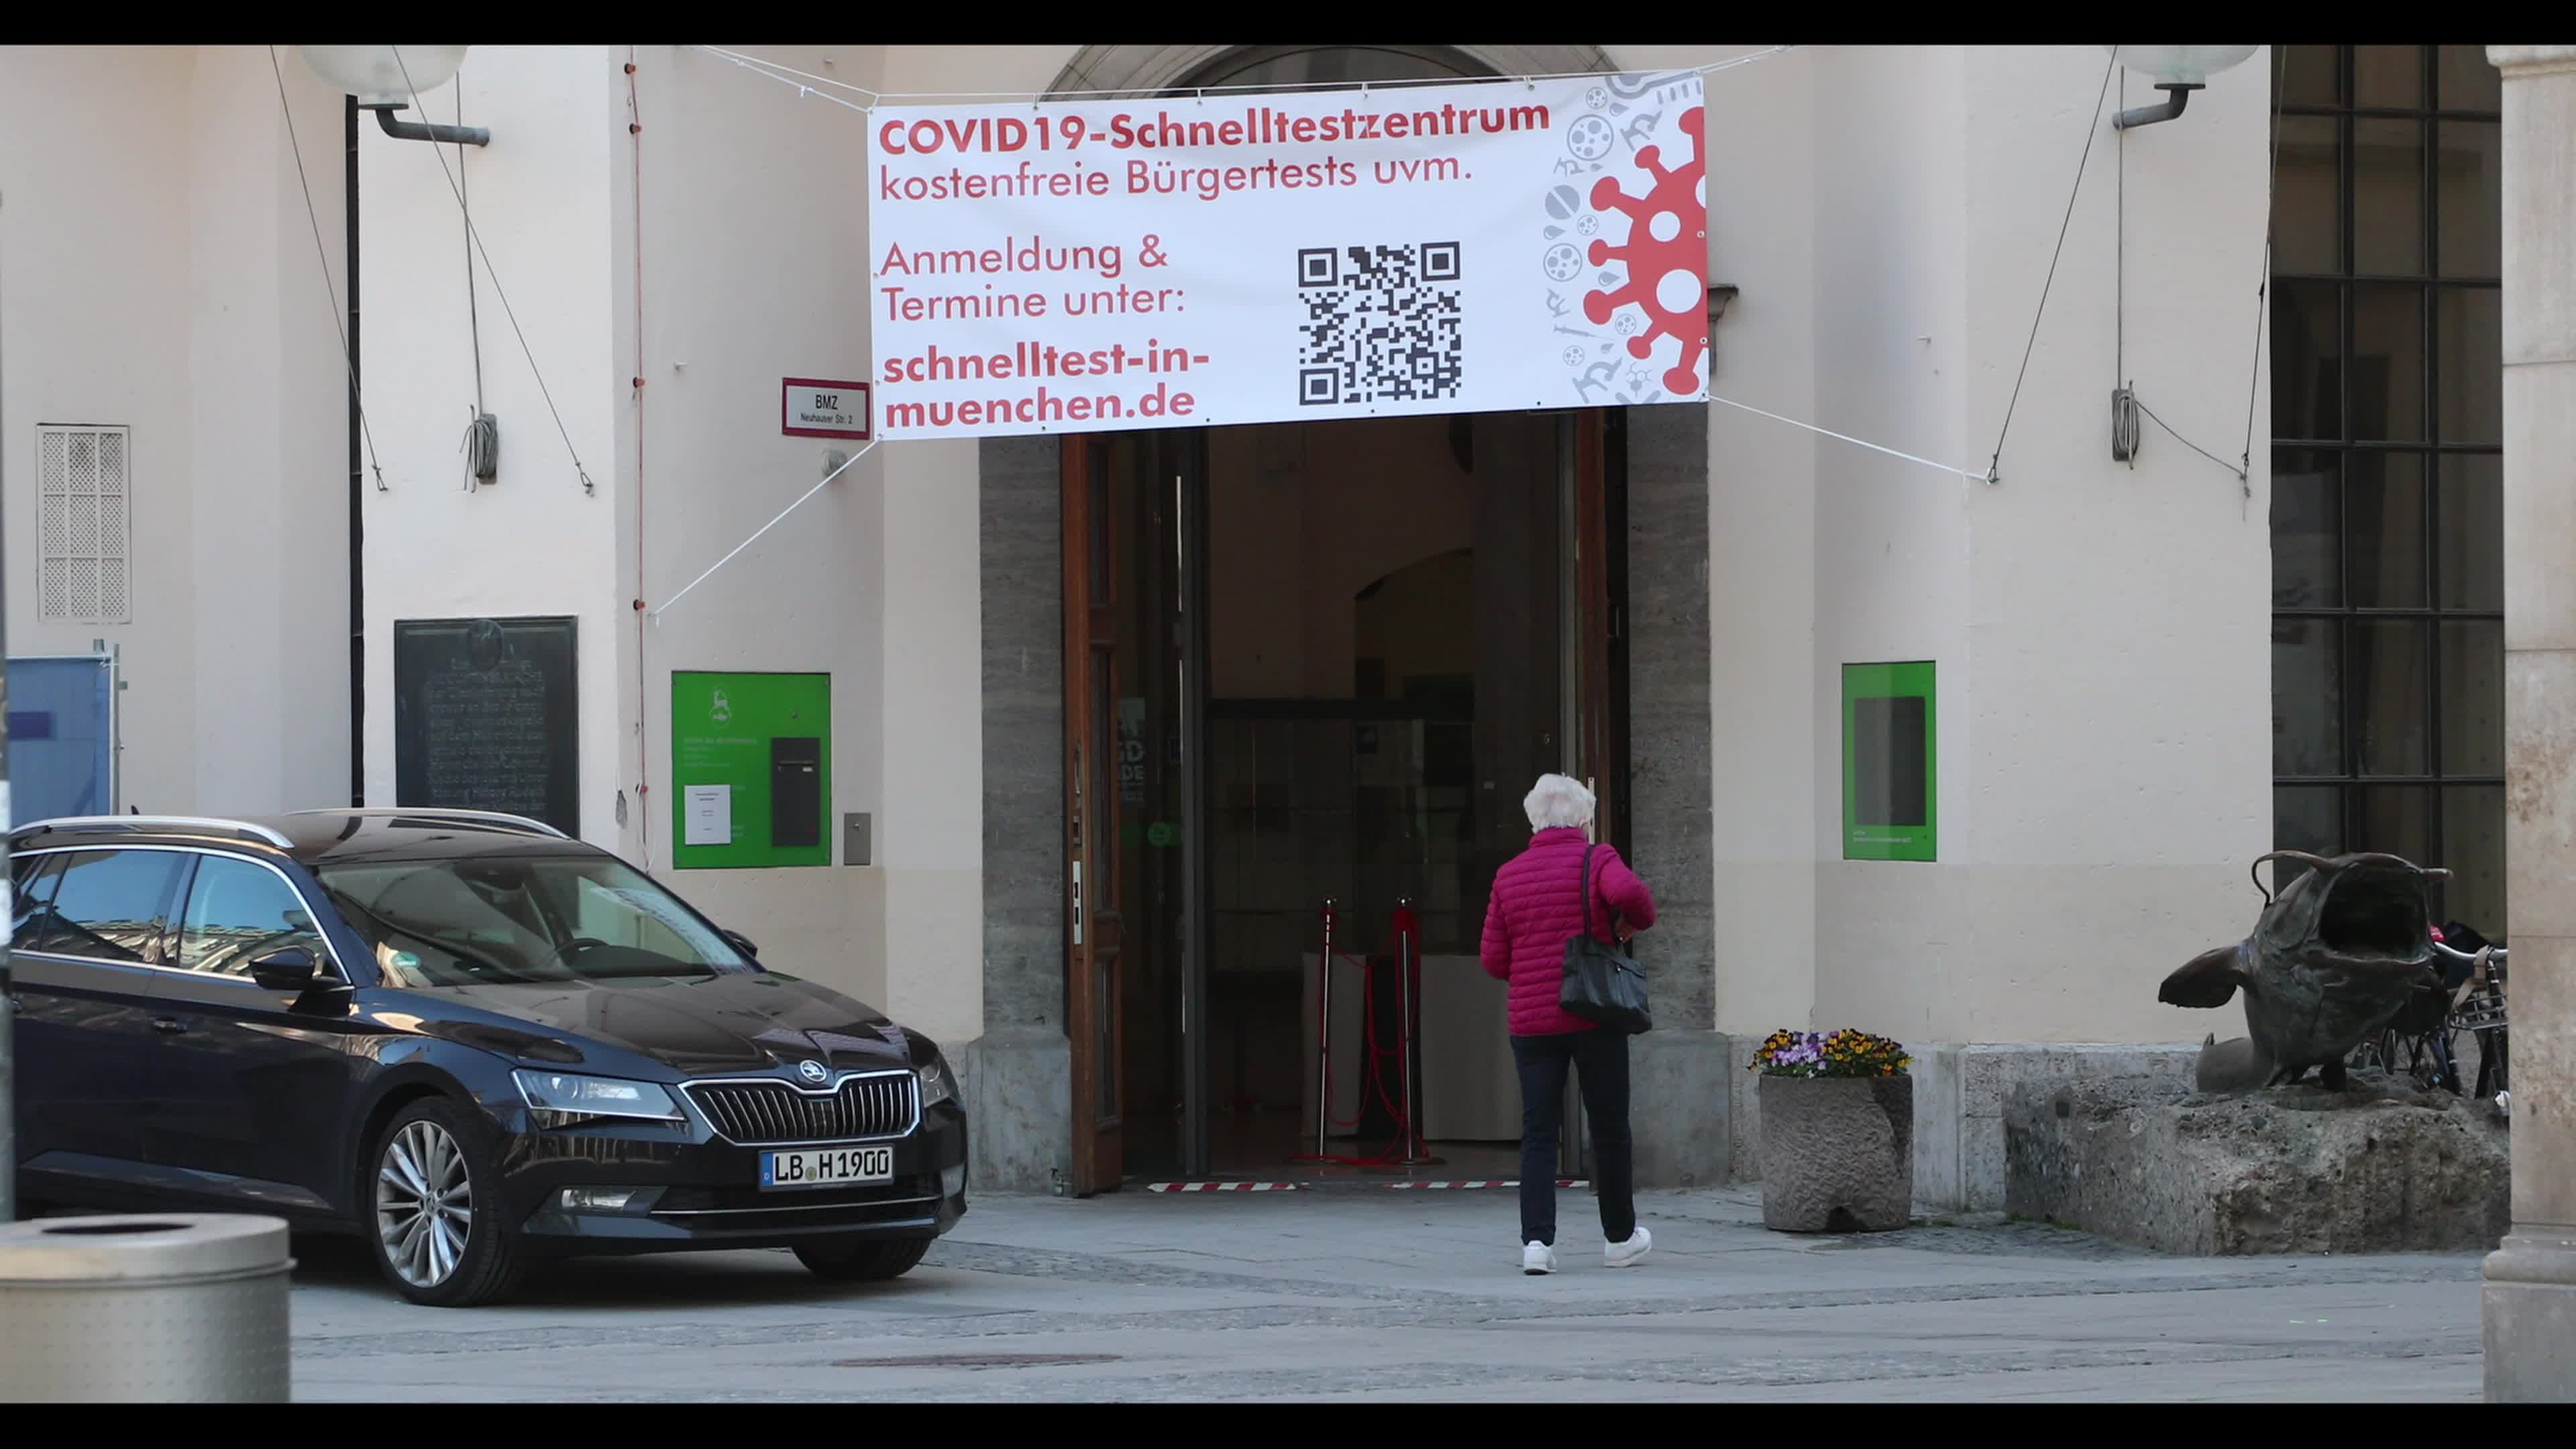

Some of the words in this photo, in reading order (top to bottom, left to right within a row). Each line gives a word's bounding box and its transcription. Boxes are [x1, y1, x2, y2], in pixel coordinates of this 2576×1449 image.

[880, 104, 1549, 154] COVID19-Schnelltestzentrum
[882, 161, 1109, 200] kostenfreie
[1128, 156, 1356, 200] Bürgertests
[1375, 158, 1470, 183] uvm.
[881, 236, 1120, 278] Anmeldung
[1140, 235, 1166, 267] &
[881, 284, 1045, 320] Termine
[1065, 285, 1183, 315] unter:
[885, 339, 1208, 382] schnelltest-in-
[816, 394, 837, 410] BMZ
[885, 382, 1193, 427] muenchen.de
[775, 1155, 804, 1181] LB
